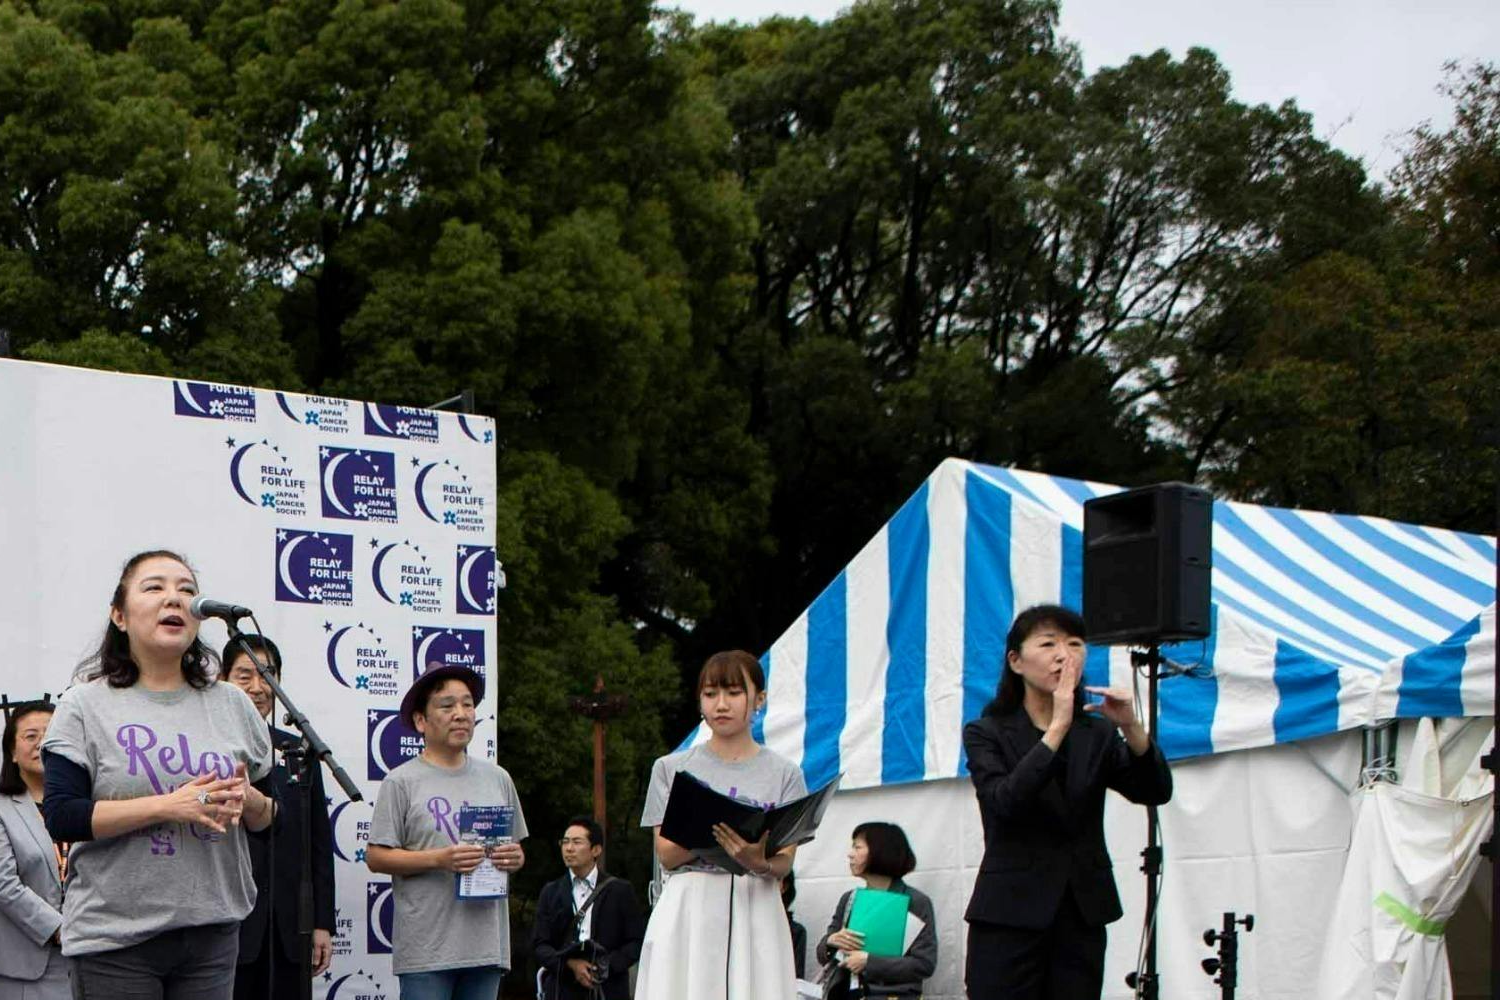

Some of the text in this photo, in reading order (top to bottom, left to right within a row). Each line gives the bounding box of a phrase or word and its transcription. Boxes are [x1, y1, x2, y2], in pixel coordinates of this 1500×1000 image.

[209, 384, 255, 396] FOR LIFE
[224, 398, 249, 406] JAPAN
[306, 396, 349, 407] FOR LIFE
[224, 406, 255, 414] CANCER
[319, 417, 348, 425] CANCER
[410, 419, 432, 427] JAPAN
[319, 425, 349, 434] SOCIETY
[409, 427, 437, 435] CANCER
[261, 465, 293, 477] RELAY
[261, 476, 306, 489] FOR LIFE
[353, 475, 385, 486] RELAY
[354, 486, 396, 497] FOR LIFE
[443, 484, 473, 495] RELAY
[275, 491, 299, 499] JAPAN
[275, 500, 305, 508] CANCER
[368, 500, 390, 508] JAPAN
[443, 494, 484, 506] FOR LIFE
[275, 508, 306, 516] SOCIETY
[367, 508, 396, 517] CANCER
[456, 516, 484, 524] CANCER
[457, 524, 485, 532] SOCIETY
[310, 557, 342, 568] RELAY
[310, 568, 353, 580] FOR LIFE
[401, 565, 432, 576] RELAY
[322, 582, 346, 590] JAPAN
[401, 576, 442, 587] FOR LIFE
[322, 591, 352, 599] CANCER
[413, 589, 436, 597] JAPAN
[412, 597, 441, 605] CANCER
[413, 605, 442, 613] SOCIETY
[356, 648, 387, 658] RELAY
[445, 653, 475, 663] RELAY
[357, 659, 399, 670] FOR LIFE
[400, 736, 425, 746] RELA
[356, 833, 369, 841] FO
